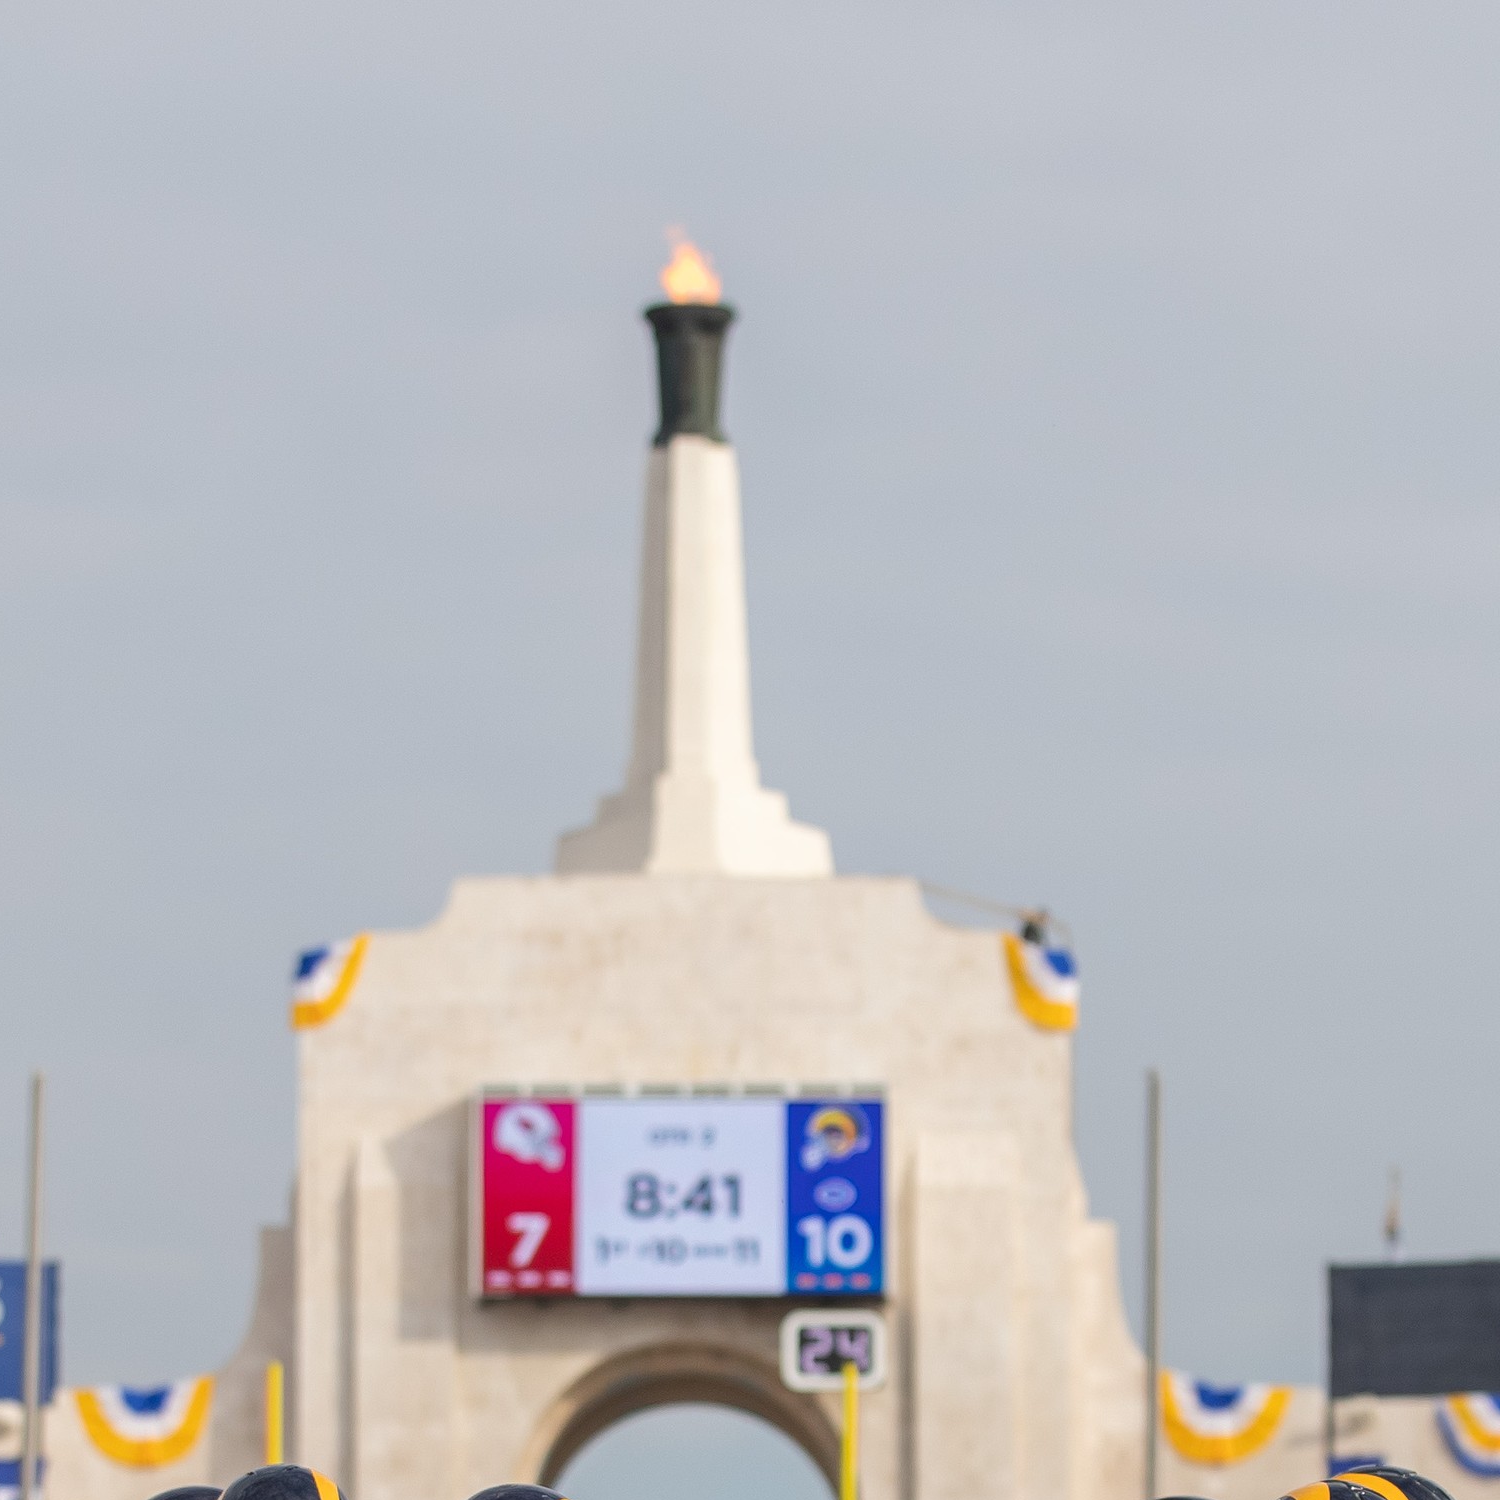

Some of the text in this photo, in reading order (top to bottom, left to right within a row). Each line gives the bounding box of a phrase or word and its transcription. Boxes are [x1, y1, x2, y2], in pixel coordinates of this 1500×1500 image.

[626, 1171, 741, 1219] 8:41
[504, 1212, 551, 1268] 7
[797, 1214, 873, 1269] 10
[799, 1326, 870, 1374] 24
